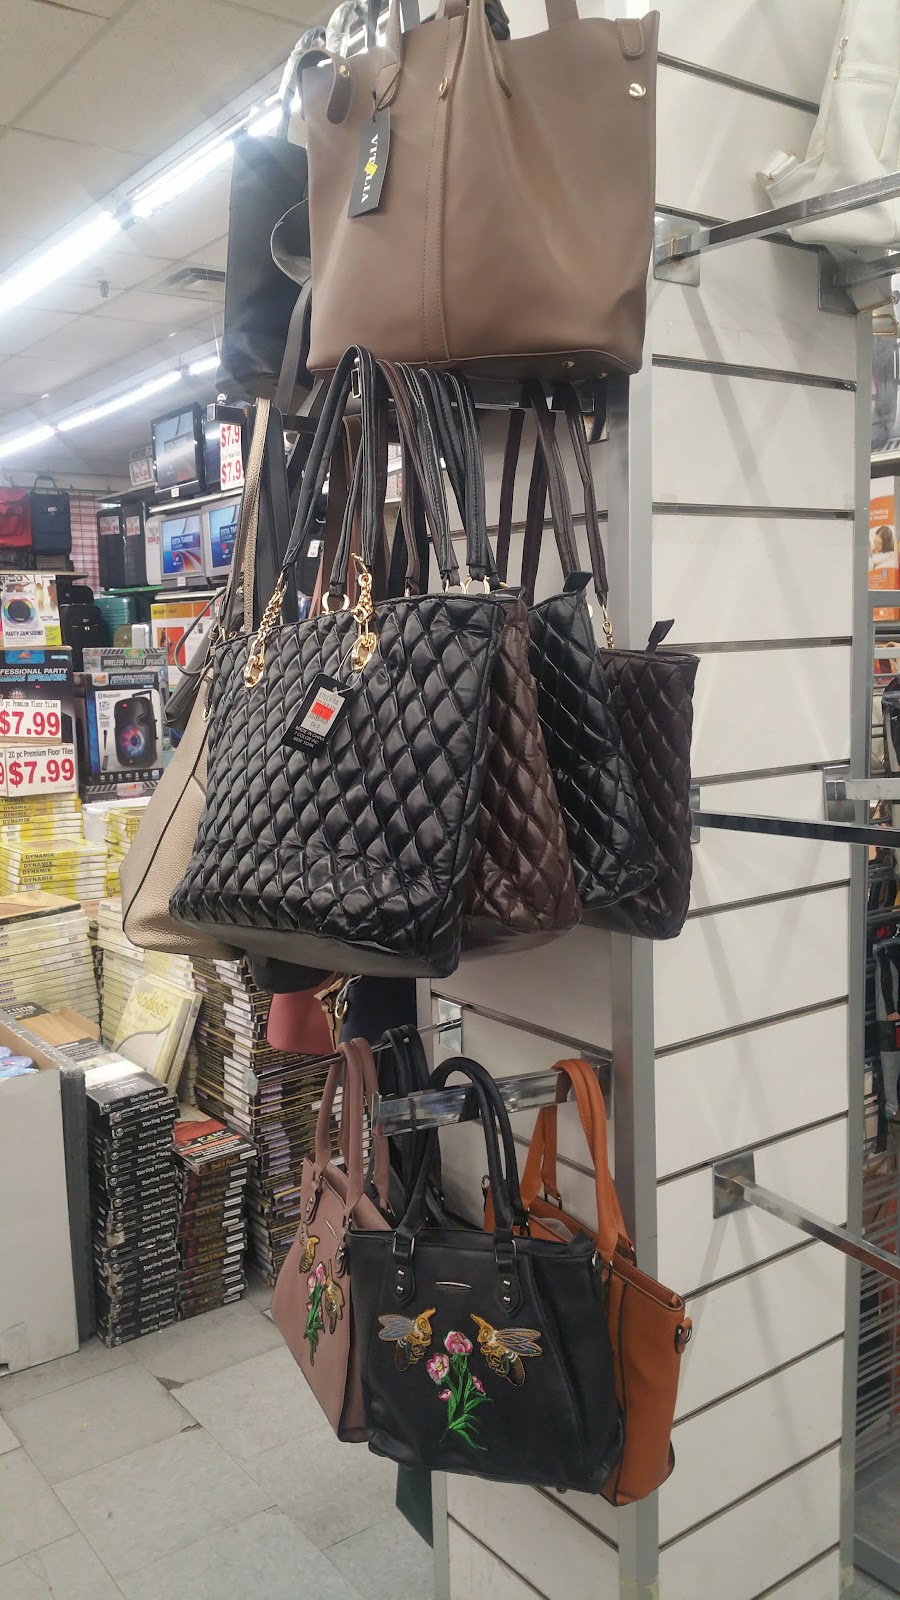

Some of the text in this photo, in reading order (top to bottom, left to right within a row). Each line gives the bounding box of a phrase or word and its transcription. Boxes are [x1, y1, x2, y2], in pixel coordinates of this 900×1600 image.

[361, 133, 378, 204] VITLIA
[221, 426, 240, 448] $7.9
[221, 527, 230, 536] ESTA
[181, 535, 193, 543] TARDE
[0, 709, 60, 736] $7.99
[24, 749, 46, 757] Premium
[9, 758, 74, 788] $7.99
[130, 992, 168, 1017] Madison
[130, 1089, 164, 1103] Sterling Planks
[140, 1104, 158, 1112] Sterling
[142, 1118, 160, 1127] Sterling
[139, 1129, 157, 1138] Sterling
[138, 1142, 156, 1150] Sterling
[138, 1155, 156, 1163] Sterling
[136, 1167, 154, 1176] Sterling
[142, 1177, 159, 1185] Sterling
[141, 1188, 159, 1197] Sterling
[143, 1201, 161, 1209] Sterling
[142, 1212, 160, 1221] Sterling
[142, 1224, 160, 1233] Sterling
[138, 1238, 156, 1247] Sterling
[139, 1252, 157, 1261] Sterling
[143, 1261, 162, 1271] Sterling
